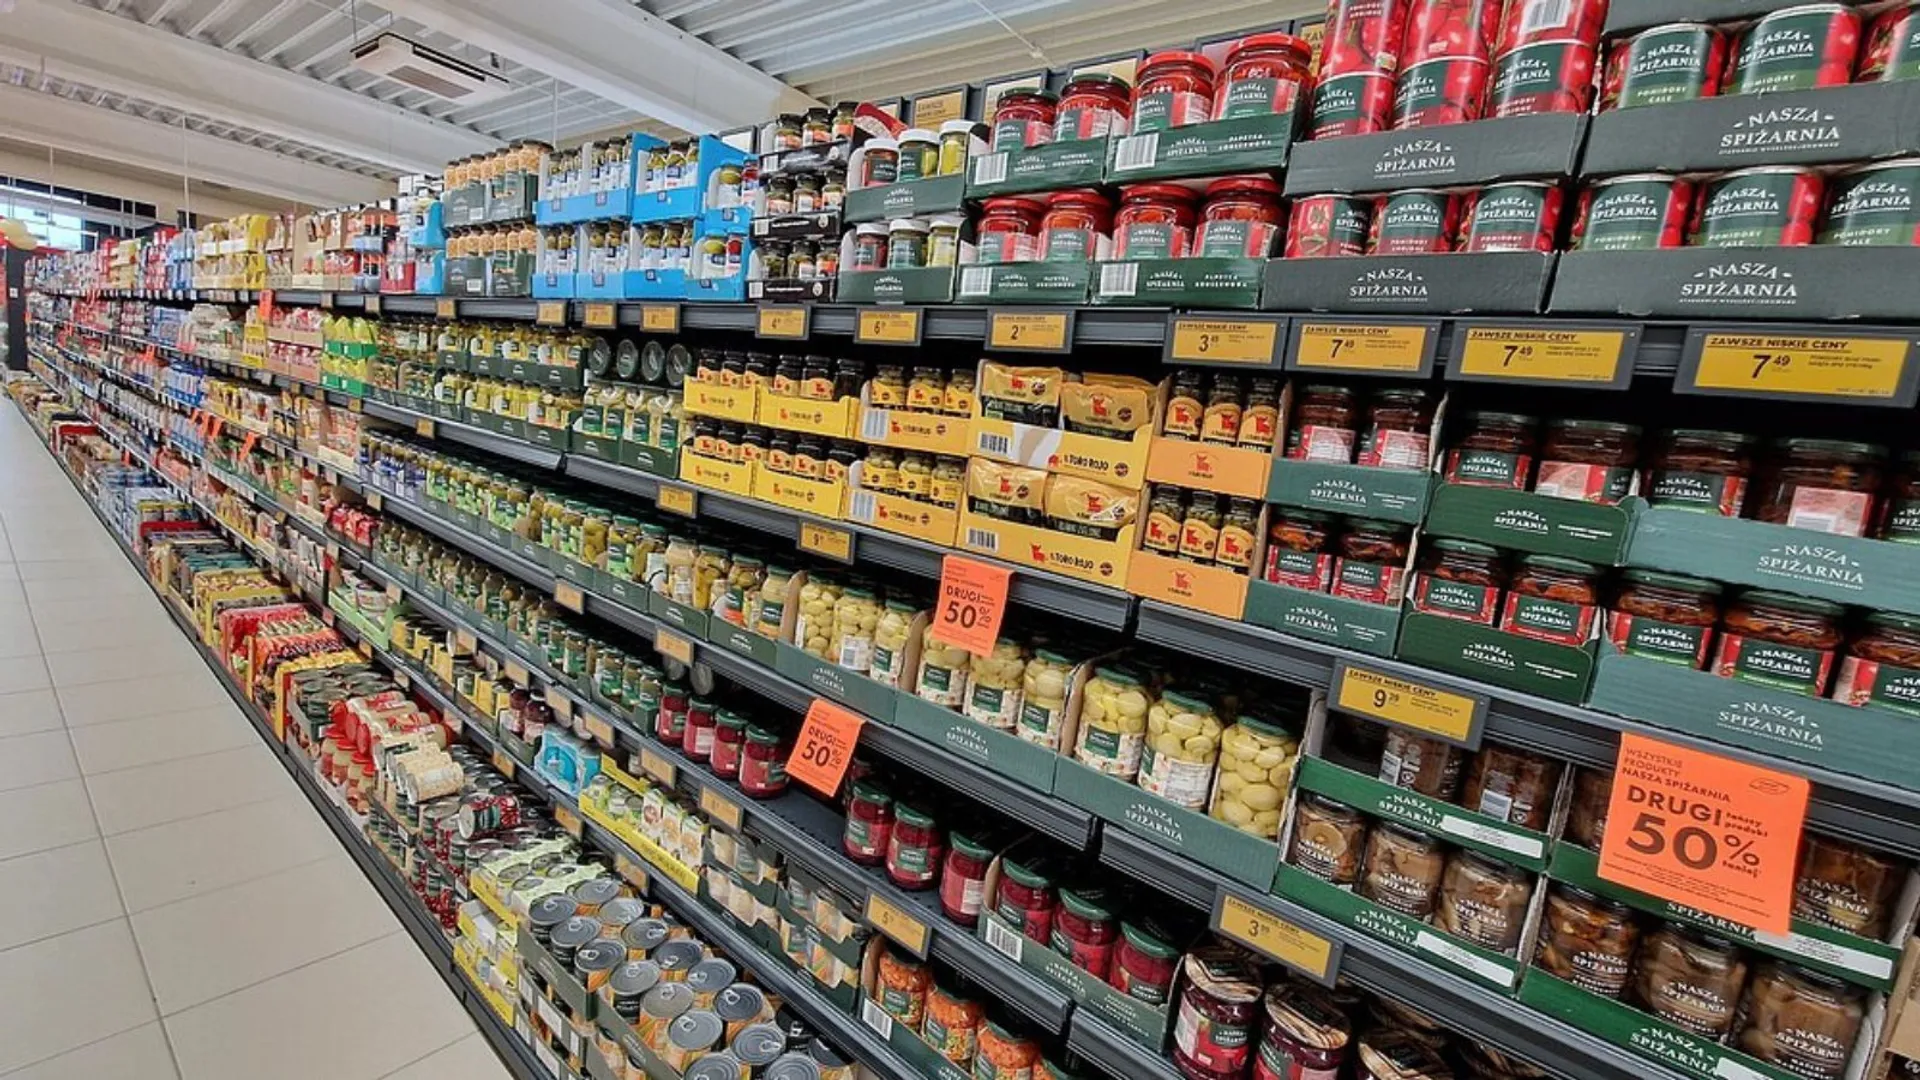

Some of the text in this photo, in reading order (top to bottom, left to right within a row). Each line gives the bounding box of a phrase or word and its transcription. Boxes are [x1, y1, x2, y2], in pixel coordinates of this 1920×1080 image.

[1755, 30, 1801, 47] NASZA
[1648, 44, 1692, 58] NASZA
[1739, 42, 1814, 65] SPIŻARNIA
[1634, 55, 1701, 72] SPIŻARNIA
[1749, 107, 1817, 128] NASZA
[1721, 126, 1840, 147] SPIŻARNIA
[1394, 141, 1441, 157] NASZA
[1375, 157, 1456, 172] SPIŻARNIA
[1721, 188, 1766, 201] NASZA
[1848, 182, 1896, 198] NASZA
[1491, 197, 1526, 208] NASZA
[1605, 194, 1646, 206] NASZA
[1705, 201, 1779, 216] SPIŻARNIA
[1831, 196, 1911, 214] SPIŻARNIA
[1477, 208, 1536, 219] SPIŻARNIA
[1592, 205, 1657, 218] SPIŻARNIA
[1367, 269, 1413, 281] NASZA
[1708, 262, 1778, 280] NASZA
[1350, 281, 1428, 296] SPIŻARNIA
[1681, 281, 1797, 297] SPIŻARNIA
[1199, 334, 1209, 352] 3
[1471, 331, 1576, 341] ZAWSZE NISKIE CENY
[1711, 337, 1848, 349] ZAWSZE NISKIE CENY
[1331, 339, 1343, 358] 7
[1503, 346, 1518, 367] 7
[1752, 355, 1771, 379] 7
[1666, 478, 1703, 489] NASZA
[1655, 486, 1711, 499] SPIŻARNIA
[1785, 544, 1848, 566] NASZA
[1758, 556, 1864, 585] SPIŻARNIA
[1638, 634, 1694, 650] SPIŻARNIA
[1650, 629, 1686, 641] NASZA
[1762, 650, 1802, 664] NASZA
[1748, 657, 1811, 675] SPIŻARNIA
[1373, 688, 1387, 708] 9
[1744, 702, 1806, 726] NASZA
[1719, 711, 1824, 744] SPIŻARNIA
[1626, 748, 1683, 768] WSZYSTKIE
[1624, 758, 1681, 777] PRODUKTY
[1622, 767, 1731, 803] NASZA SPIŻARNIA
[1395, 794, 1434, 815] NASZA
[1627, 784, 1721, 826] DRUGI
[1812, 878, 1859, 902] NASZA
[1248, 920, 1259, 937] 3
[1370, 910, 1408, 932] NASZA
[1651, 1028, 1707, 1056] NASZA
